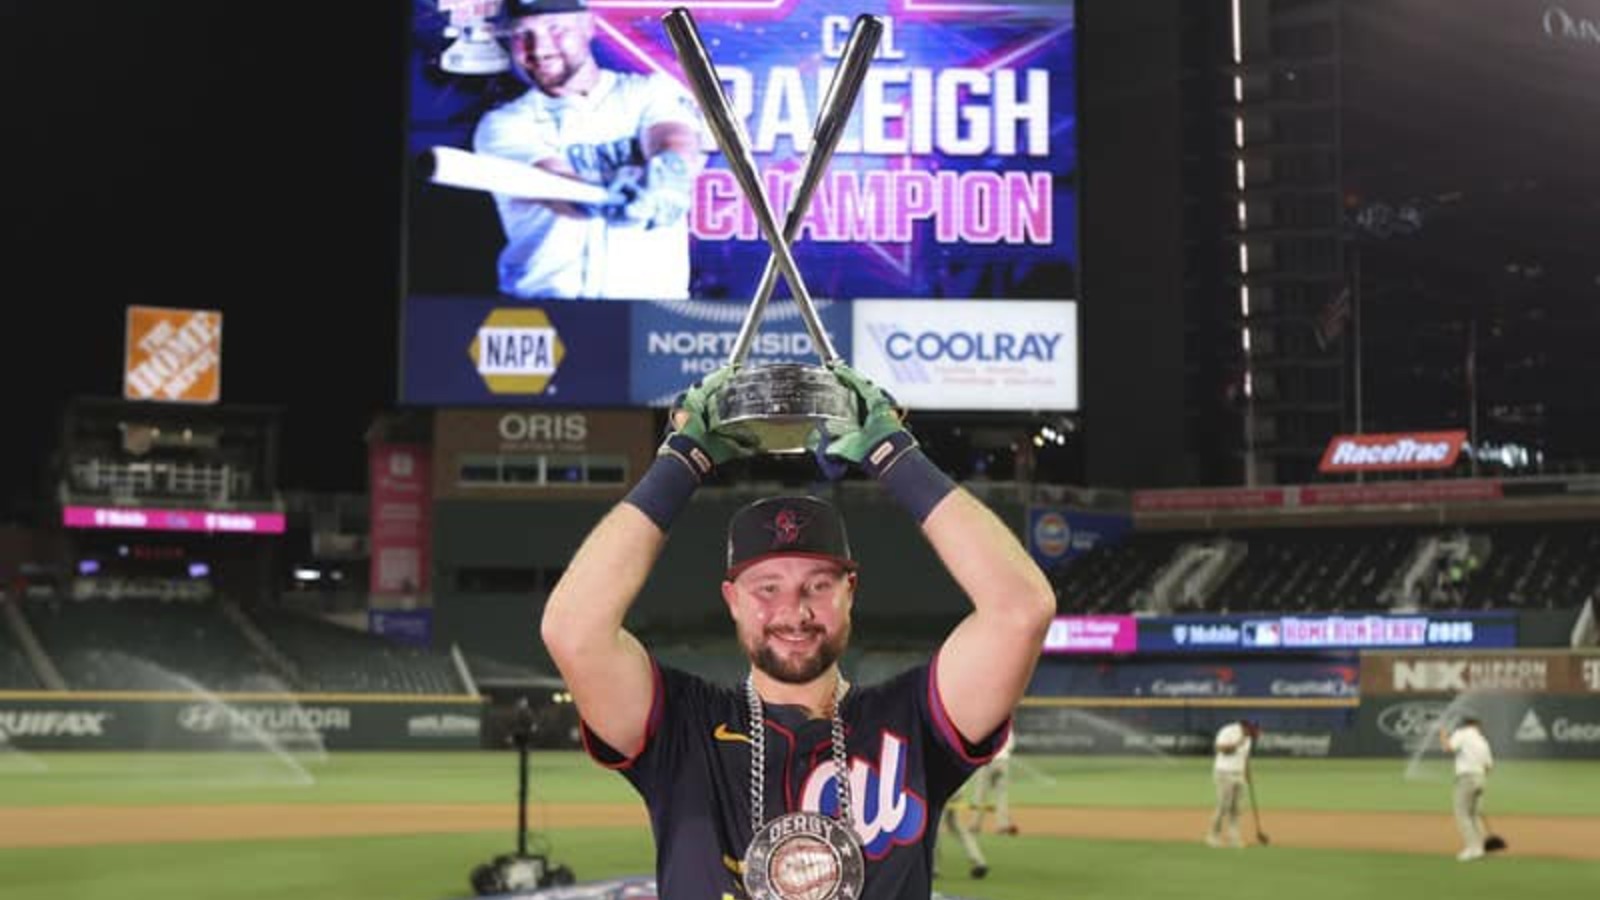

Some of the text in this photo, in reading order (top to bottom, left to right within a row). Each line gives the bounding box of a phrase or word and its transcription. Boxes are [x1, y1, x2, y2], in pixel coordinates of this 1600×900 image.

[821, 15, 905, 60] CL
[127, 311, 221, 399] HOME
[486, 334, 548, 369] NAPA
[885, 331, 1062, 362] COOLRAY
[499, 413, 587, 441] ORIS
[1331, 438, 1451, 466] RaceTrac
[1281, 617, 1329, 646] HOME
[1365, 616, 1427, 645] DERBY
[1428, 621, 1473, 643] 2025
[769, 815, 833, 844] DERBY
